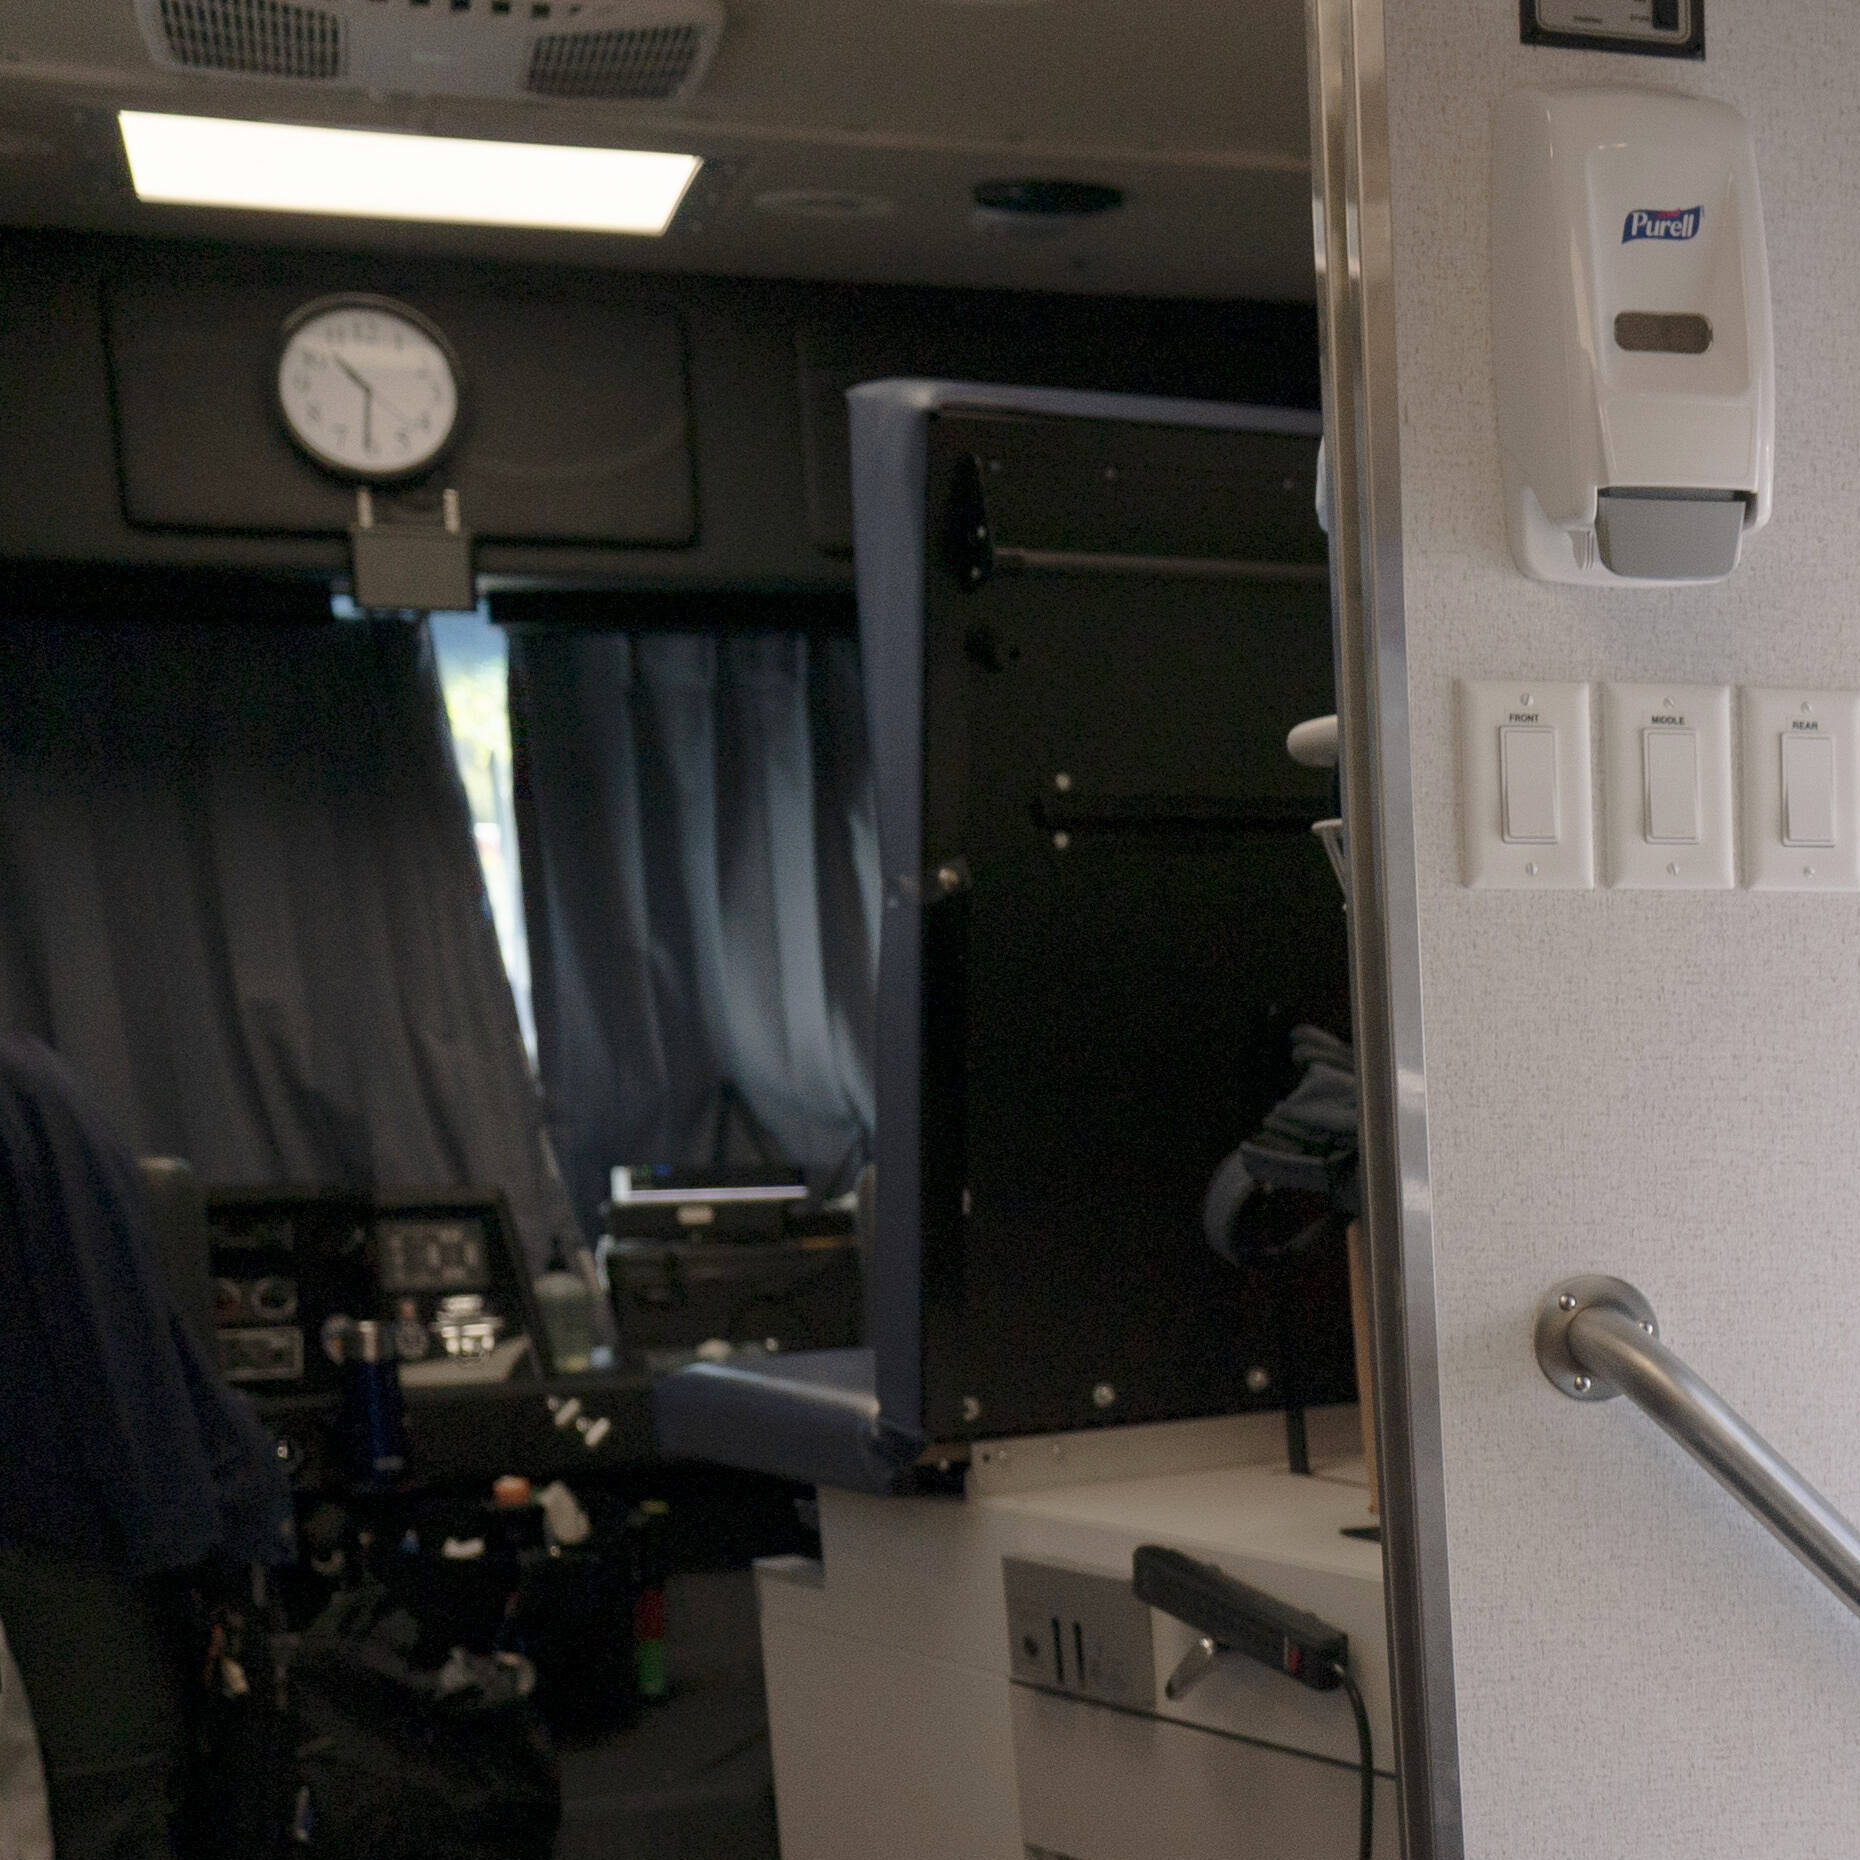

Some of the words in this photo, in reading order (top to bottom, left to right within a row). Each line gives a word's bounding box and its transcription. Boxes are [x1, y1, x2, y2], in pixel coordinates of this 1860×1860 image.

[1631, 211, 1696, 238] Purell
[1509, 713, 1539, 723] FRONT
[1651, 715, 1685, 725] MIDDLE
[1792, 721, 1818, 730] REAR
